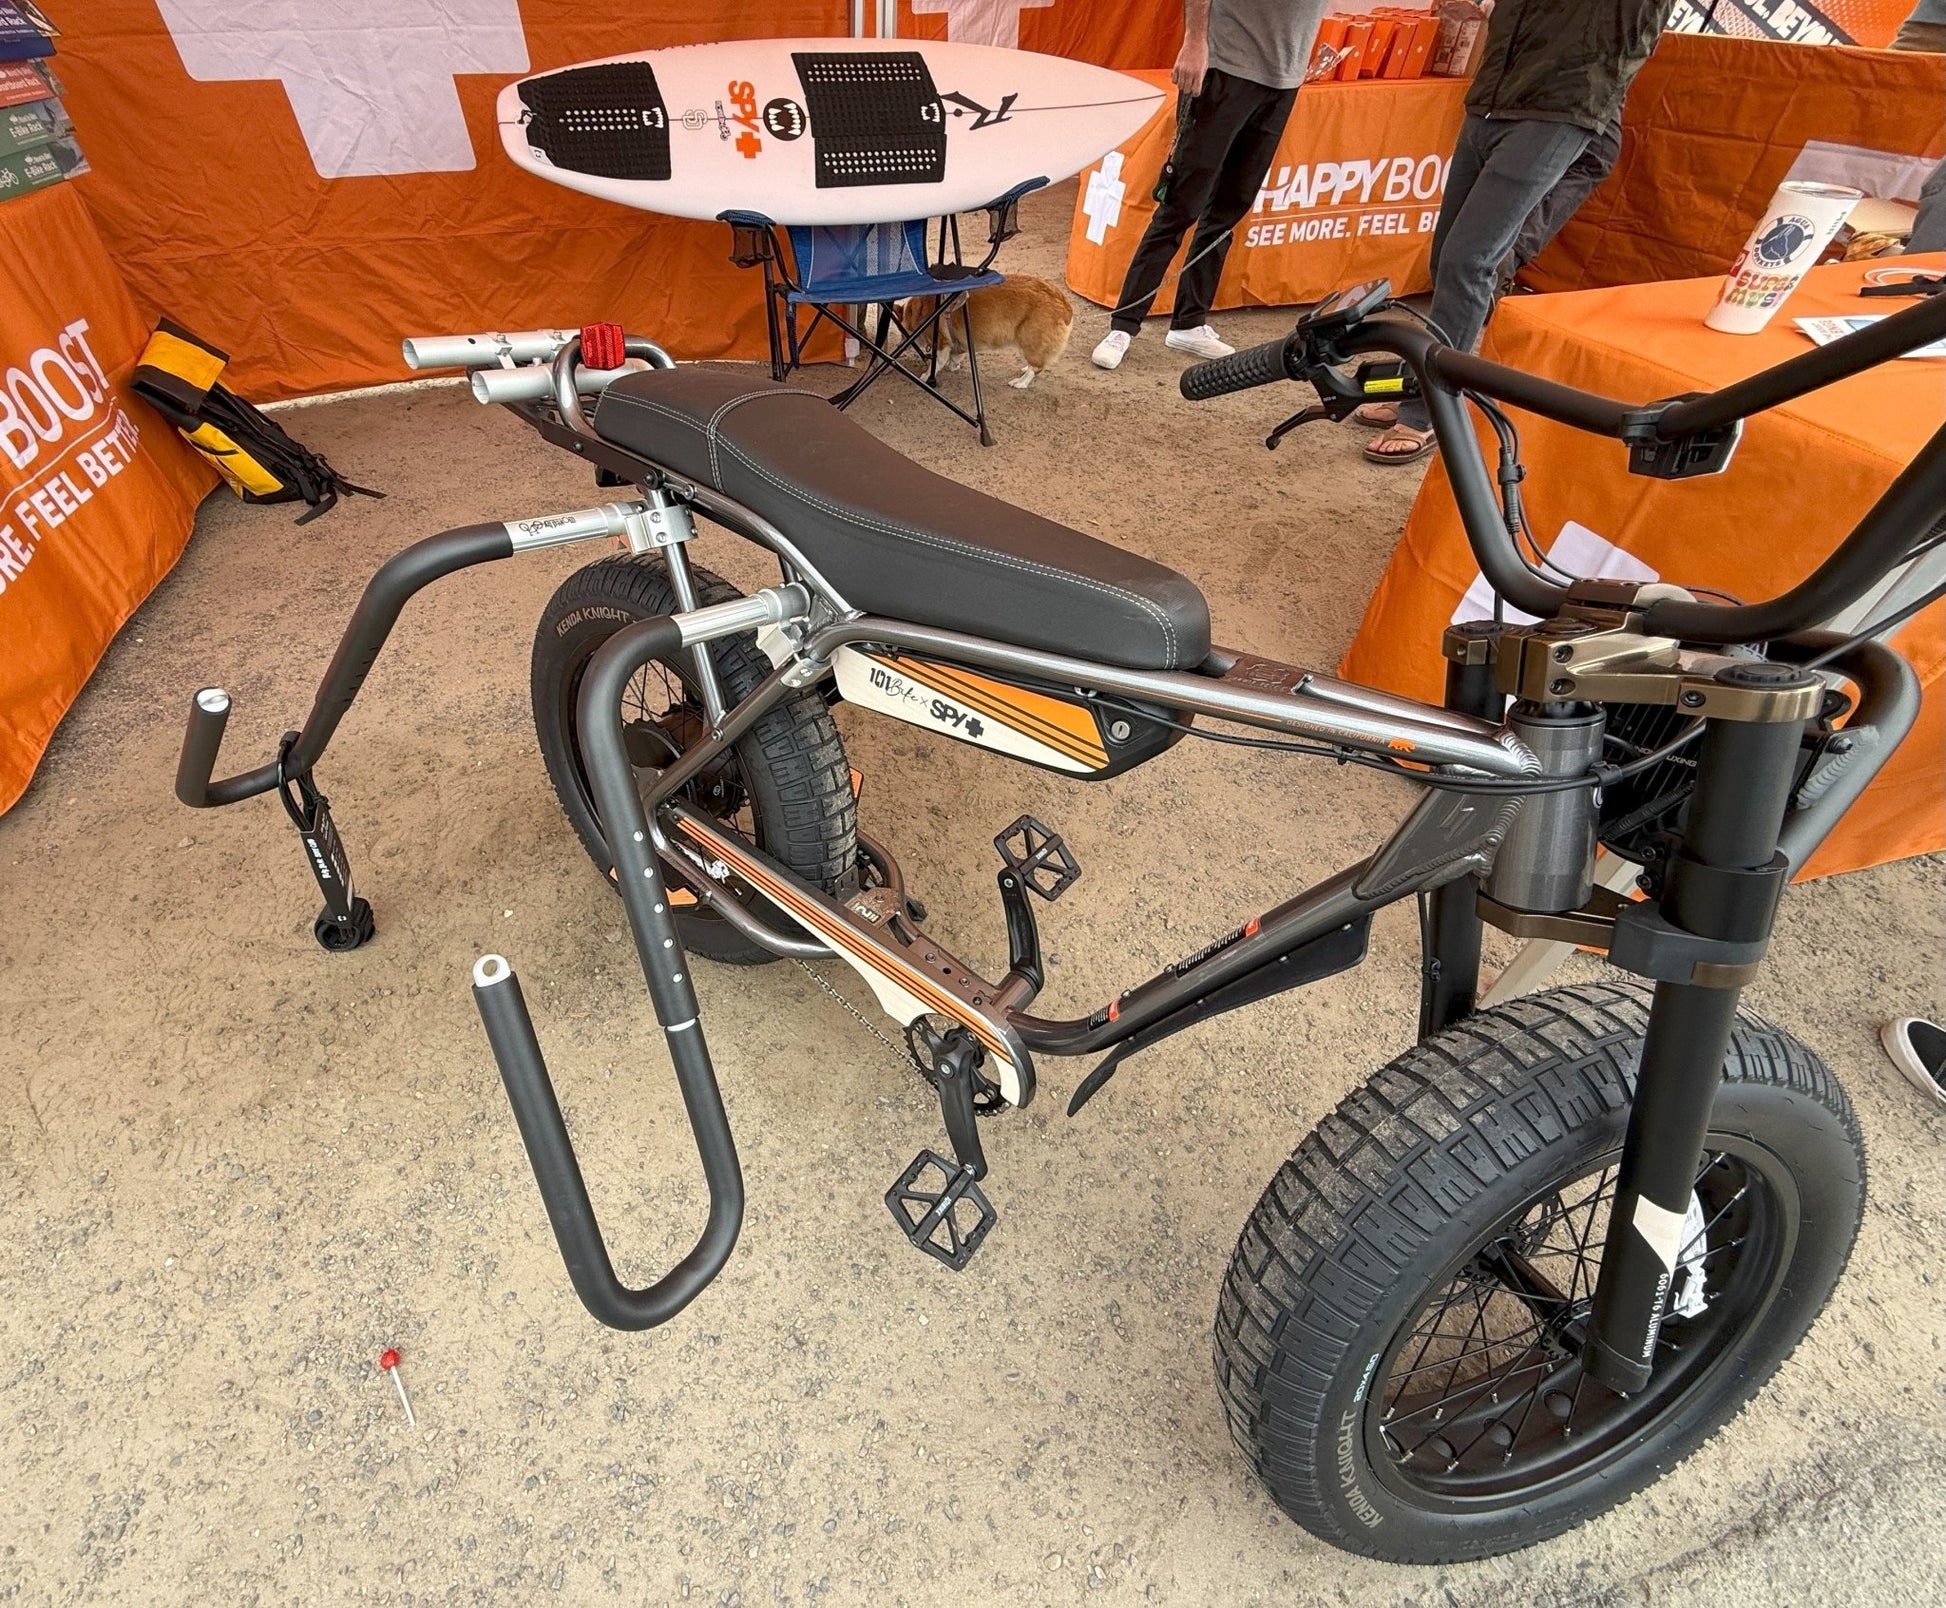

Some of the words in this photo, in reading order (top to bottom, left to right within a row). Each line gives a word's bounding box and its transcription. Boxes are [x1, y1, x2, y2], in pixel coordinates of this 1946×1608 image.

[1252, 154, 1453, 214] HAPPYBO
[1244, 223, 1287, 248] SEE
[1288, 216, 1351, 244] MORE.
[1357, 212, 1410, 237] FEEL
[1788, 216, 1811, 230] AGUA
[14, 471, 95, 542] FEEL
[556, 610, 583, 638] KENDA
[582, 606, 630, 624] KNIGHT
[1286, 719, 1327, 733] DESIGNED
[1327, 727, 1337, 735] IN
[1338, 728, 1386, 745] CALIFORNIA
[1652, 1272, 1669, 1311] 6061-T6
[1641, 1312, 1661, 1358] ALUMINUM
[1336, 1409, 1358, 1488] KNIGHT
[1344, 1484, 1385, 1529] KENDA
